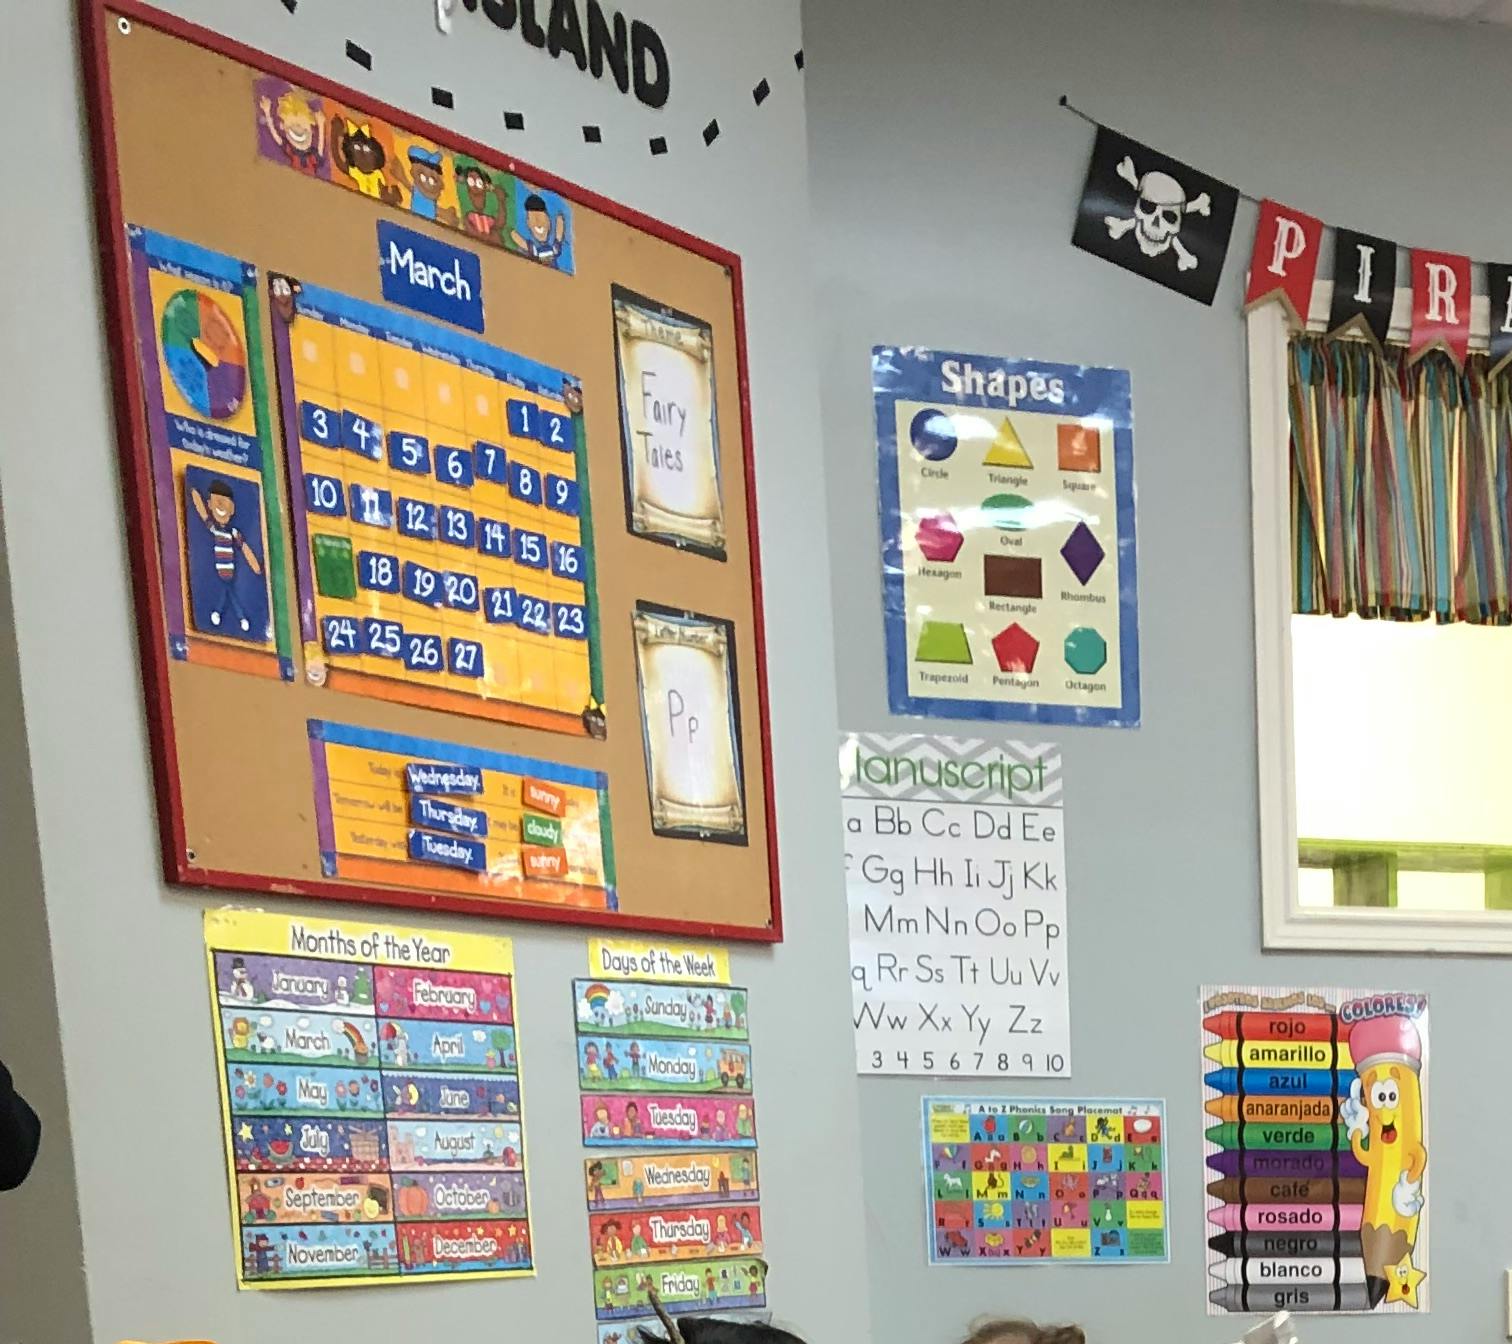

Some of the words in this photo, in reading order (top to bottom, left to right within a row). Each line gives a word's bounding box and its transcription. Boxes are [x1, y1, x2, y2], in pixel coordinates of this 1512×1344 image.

[390, 242, 471, 302] March
[942, 360, 1064, 408] Shapes
[642, 371, 687, 437] Fairy
[521, 406, 528, 432] 1
[550, 422, 564, 443] 2
[313, 409, 328, 438] 3
[353, 419, 369, 449] 4
[402, 439, 418, 465] 5
[448, 451, 462, 477] 6
[485, 449, 495, 474] 7
[520, 469, 532, 495] 8
[556, 480, 568, 503] 9
[636, 431, 683, 472] Tales
[921, 467, 948, 481] Circle
[988, 473, 1028, 487] Triangle
[312, 480, 336, 508] 10
[406, 502, 425, 530] 12
[447, 510, 467, 540] 13
[485, 524, 505, 552] 14
[520, 533, 540, 559] 15
[559, 547, 578, 573] 16
[1000, 535, 1023, 547] Oval
[918, 567, 962, 580] Hexagon
[369, 556, 392, 585] 18
[413, 569, 435, 595] 19
[447, 577, 476, 604] 20
[492, 592, 511, 617] 21
[522, 600, 546, 627] 22
[558, 607, 584, 634] 23
[1060, 592, 1106, 604] Rhombus
[989, 601, 1037, 615] Rectangle
[328, 620, 355, 648] 24
[369, 623, 400, 652] 25
[410, 638, 438, 664] 26
[455, 644, 476, 670] 27
[919, 672, 968, 686] Trapezoid
[993, 675, 1039, 690] Pentagon
[1065, 680, 1106, 693] Octagon
[529, 786, 560, 811] sunny
[527, 821, 559, 843] cloudy
[875, 806, 912, 835] Bb
[922, 808, 962, 837] Cc
[974, 811, 1011, 840] Dd
[1023, 813, 1055, 841] Ee
[530, 853, 561, 871] sunny
[862, 854, 905, 896] Gg
[914, 857, 953, 886] Hh
[965, 859, 980, 888] Ii
[988, 859, 1013, 900] Jj
[1024, 862, 1057, 891] Kk
[864, 904, 917, 935] Mm
[926, 906, 967, 935] Nn
[975, 908, 1016, 937] Oo
[1024, 909, 1060, 950] Pp
[292, 926, 356, 956] Months
[361, 932, 380, 959] of
[384, 935, 410, 959] the
[412, 939, 450, 963] Year
[602, 948, 637, 975] Days
[641, 951, 655, 973] of
[660, 952, 682, 974] the
[684, 955, 715, 977] Week
[878, 953, 908, 983] Rr
[916, 955, 944, 984] Ss
[951, 956, 979, 984] Tt
[990, 958, 1022, 985] Uu
[1029, 959, 1060, 987] Vv
[273, 970, 329, 999] January
[414, 982, 476, 1013] February
[1342, 994, 1426, 1021] COLORES!
[645, 996, 687, 1022] Sunday
[854, 1002, 907, 1030] Ww
[918, 1003, 952, 1032] Xx
[962, 1004, 990, 1045] Yy
[1009, 1005, 1042, 1035] Zz
[1269, 1018, 1306, 1038] rojo
[286, 1029, 330, 1051] March
[433, 1033, 465, 1058] April
[1249, 1046, 1326, 1063] amarillo
[649, 1057, 696, 1080] Monday
[299, 1078, 327, 1105] May
[1269, 1073, 1307, 1090] azul
[440, 1085, 468, 1107] June
[650, 1106, 696, 1131] Tuesday
[979, 1105, 985, 1113] A
[988, 1105, 999, 1113] to
[1010, 1105, 1047, 1114] Phonics
[1050, 1106, 1074, 1116] Song
[1077, 1106, 1123, 1114] Placemat
[1246, 1100, 1330, 1123] anaranjada
[302, 1128, 328, 1156] July
[434, 1131, 475, 1157] August
[1263, 1128, 1314, 1144] verde
[1253, 1154, 1324, 1171] morado
[645, 1165, 710, 1187] Wednesday
[436, 1188, 490, 1206] October
[1270, 1180, 1310, 1198] café
[286, 1188, 359, 1213] September
[1258, 1208, 1323, 1224] rosado
[651, 1219, 710, 1240] Thursday
[288, 1243, 359, 1263] November
[435, 1235, 497, 1256] December
[1264, 1236, 1317, 1256] negro
[1260, 1262, 1322, 1278] blanco
[662, 1274, 700, 1294] Friday
[1274, 1288, 1309, 1310] gris
